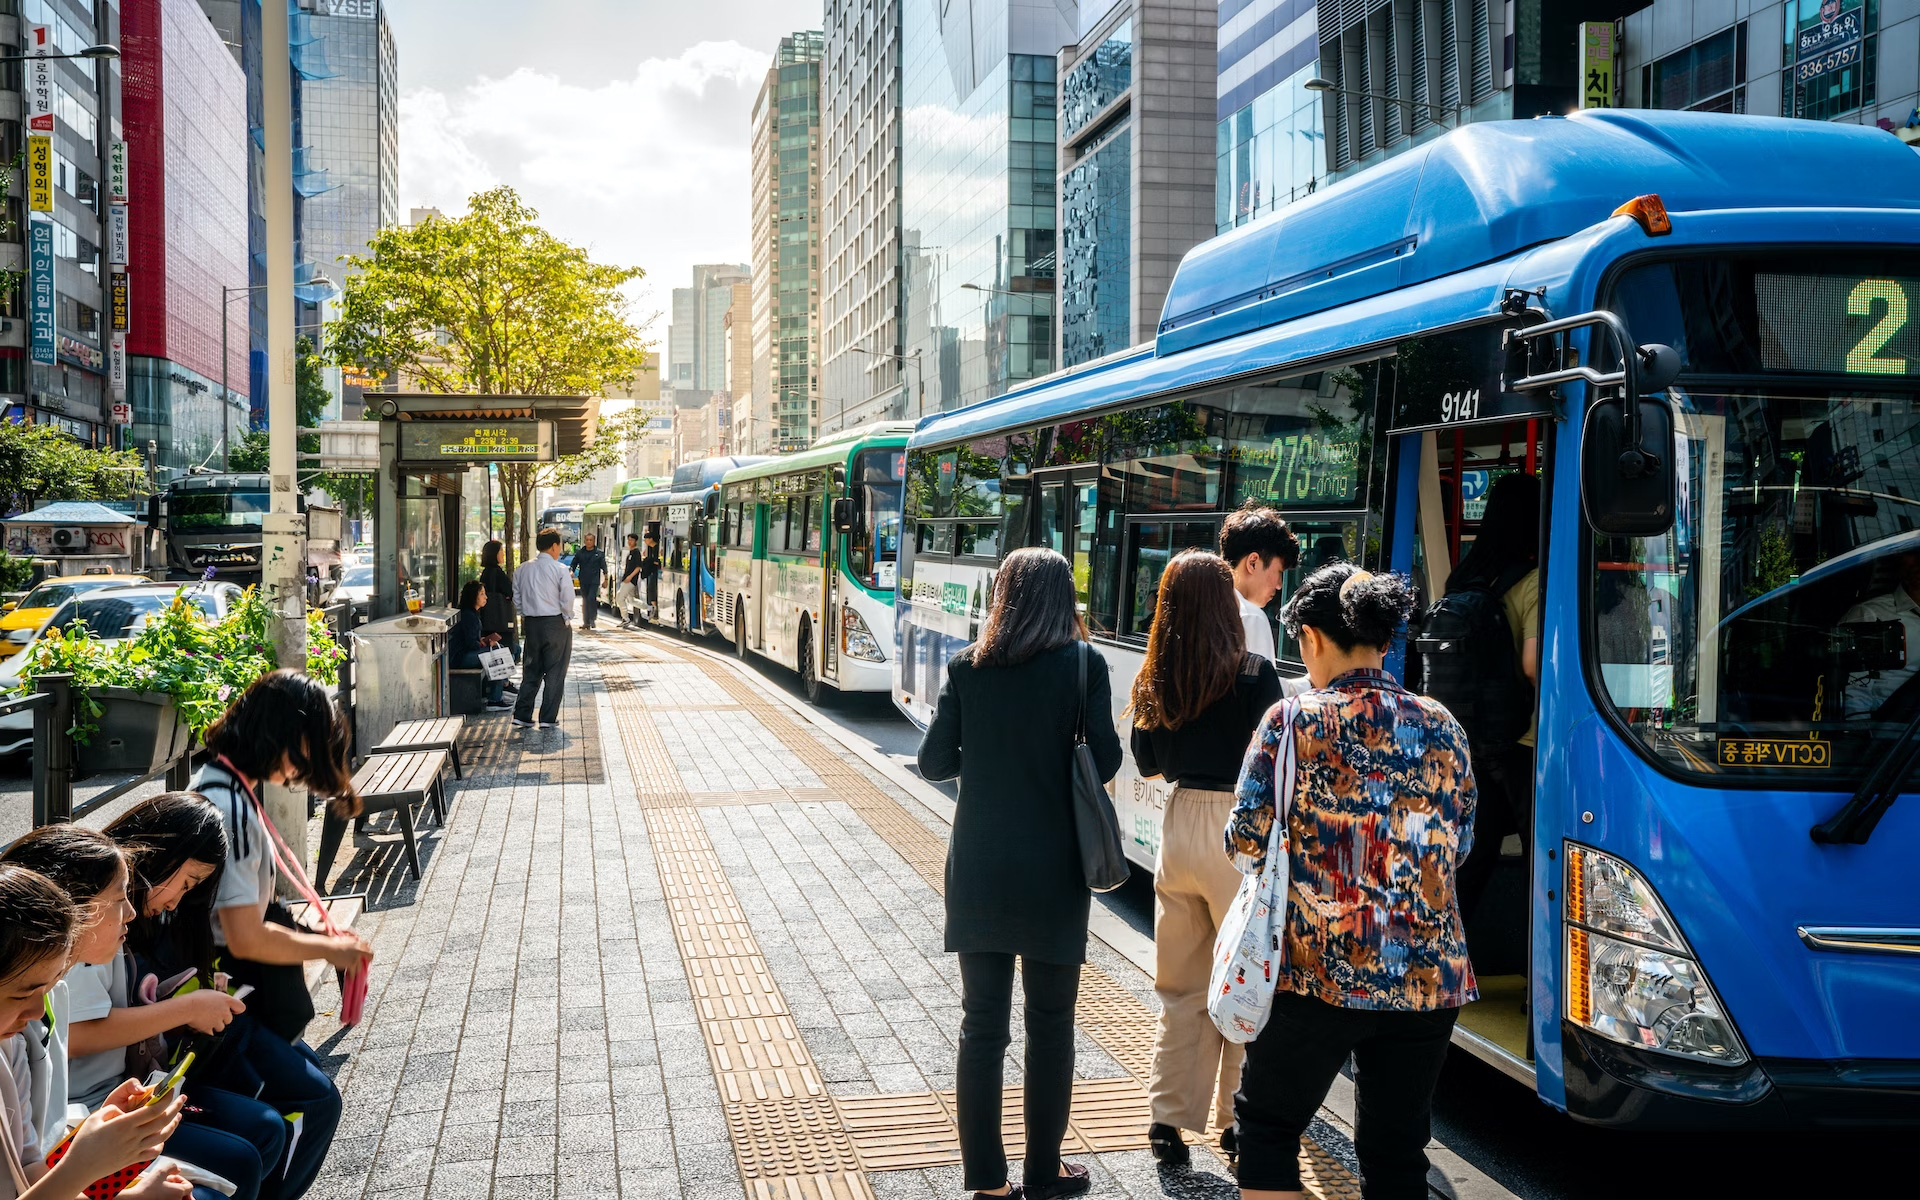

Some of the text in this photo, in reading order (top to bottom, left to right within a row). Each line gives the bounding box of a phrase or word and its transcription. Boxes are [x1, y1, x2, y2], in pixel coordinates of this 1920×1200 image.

[1800, 45, 1857, 79] 336-5757
[34, 146, 48, 205] 성형외과
[111, 143, 124, 195] 자연한의원
[35, 312, 53, 342] 치과
[113, 404, 129, 419] 약
[1441, 389, 1480, 422] 9141
[474, 428, 507, 437] 현재시각
[1266, 434, 1313, 500] 273
[671, 507, 686, 515] 271
